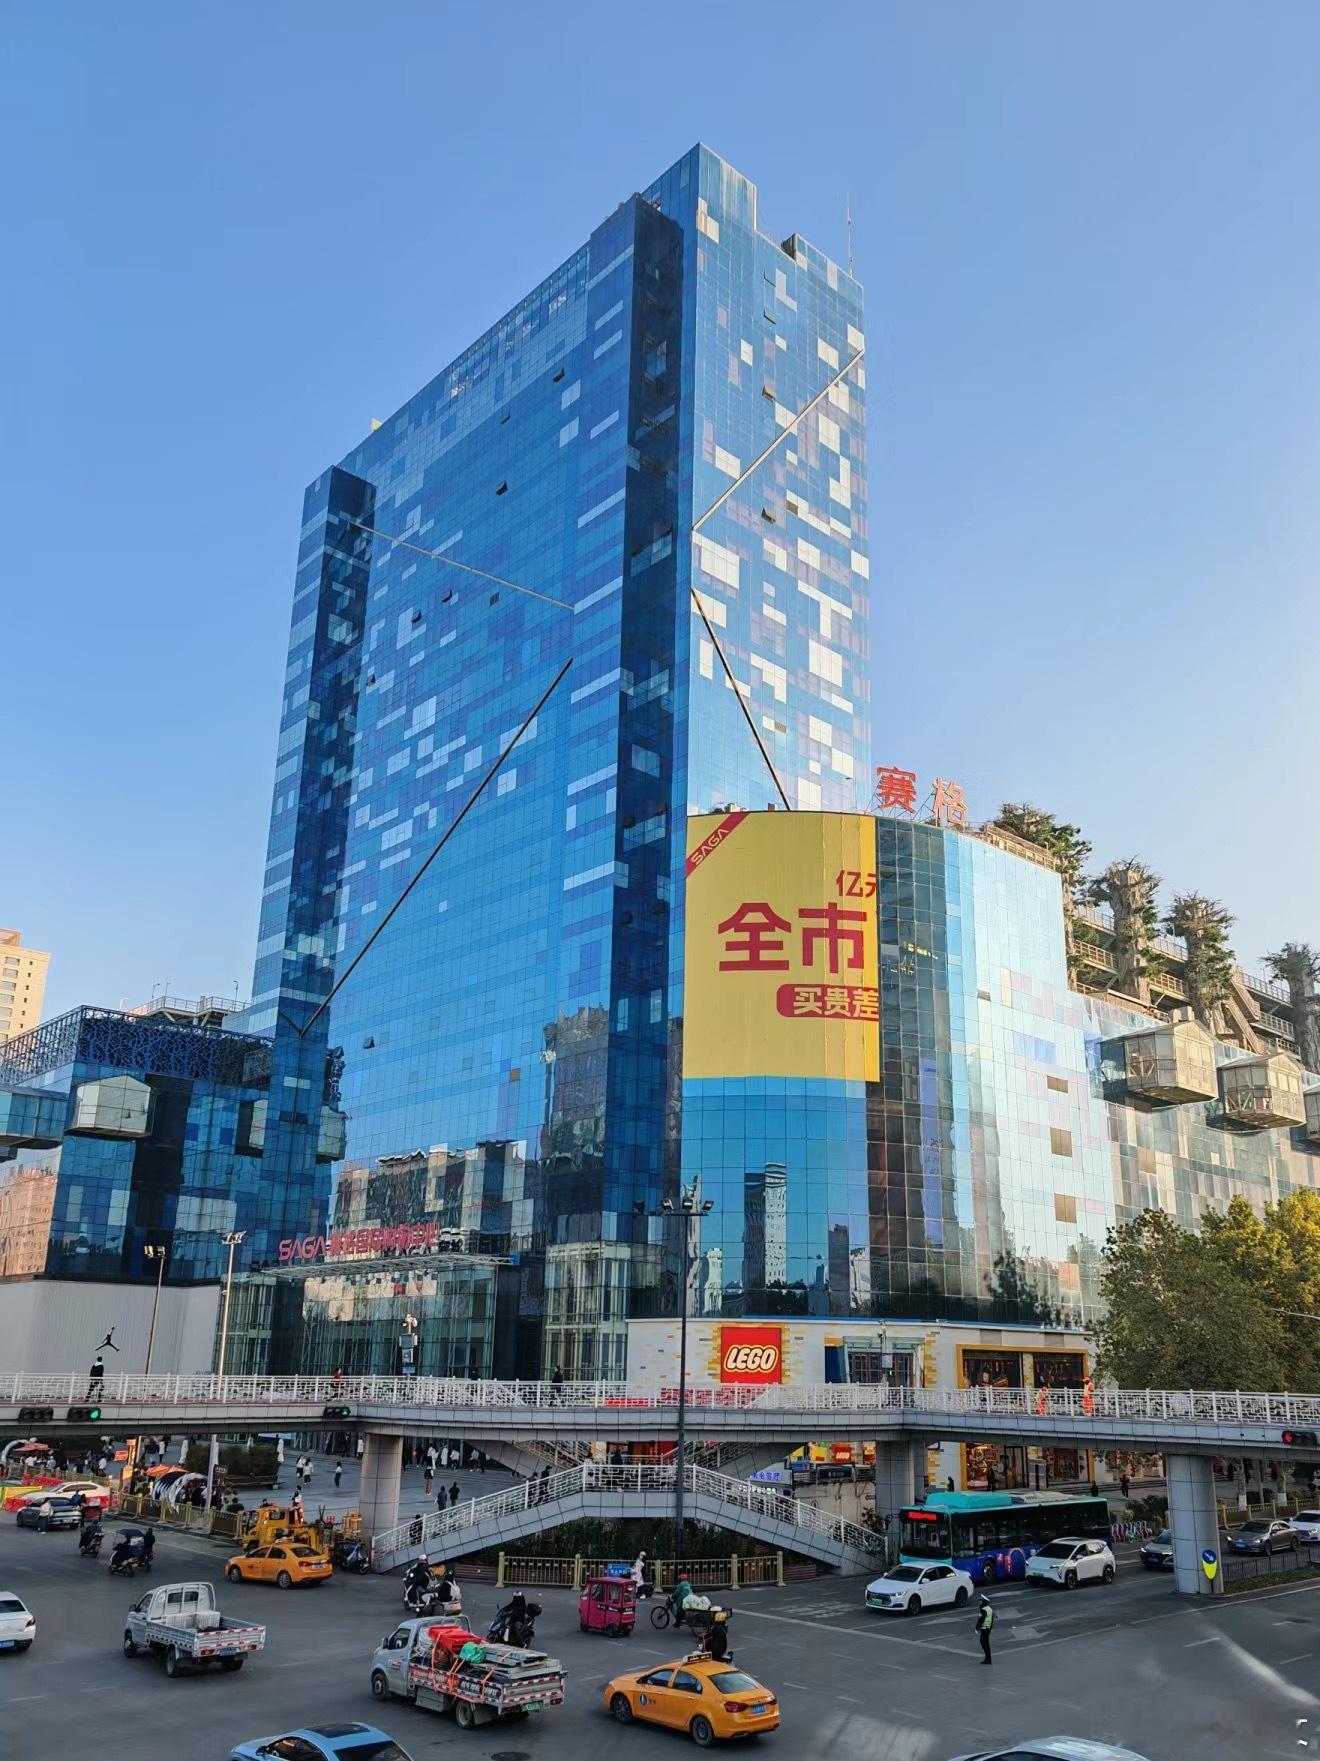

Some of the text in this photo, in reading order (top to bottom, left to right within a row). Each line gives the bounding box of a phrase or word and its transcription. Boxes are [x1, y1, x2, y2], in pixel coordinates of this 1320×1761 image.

[876, 766, 968, 826] 赛格
[690, 828, 730, 866] SAGA
[717, 902, 868, 974] 全市
[793, 987, 879, 1019] 买贵差
[278, 1235, 327, 1261] SAGA
[725, 1345, 778, 1372] LEGO
[836, 1452, 850, 1460] LEGO
